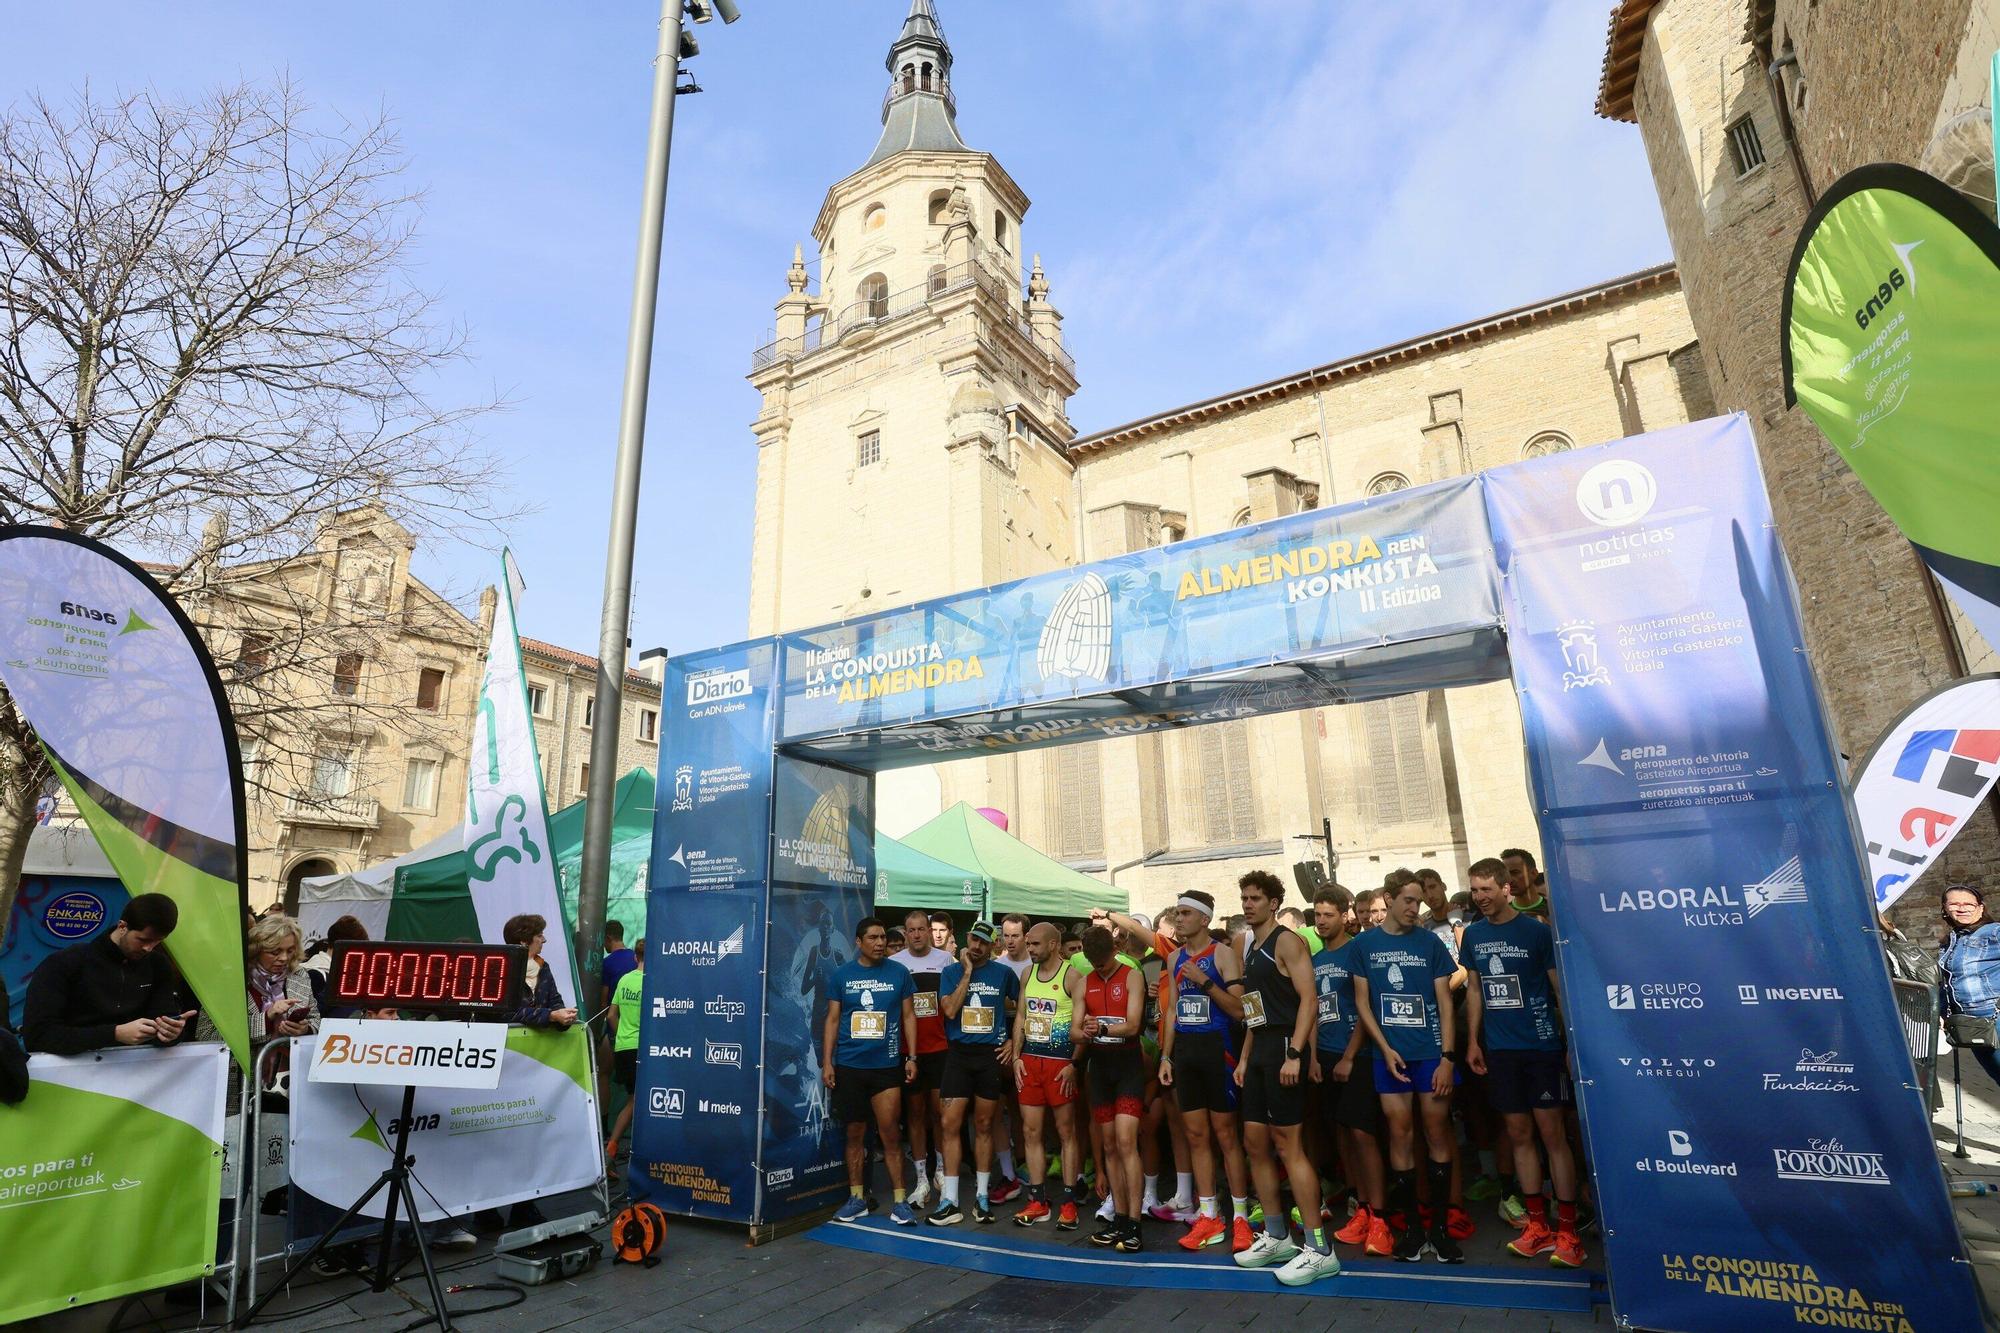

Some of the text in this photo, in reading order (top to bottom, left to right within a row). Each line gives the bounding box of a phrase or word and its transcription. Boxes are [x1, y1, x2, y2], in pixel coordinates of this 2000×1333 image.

[1580, 527, 1675, 557] noticias
[1177, 535, 1425, 602] ALMENDRA REN
[1288, 554, 1440, 603] KONKISTA
[1382, 584, 1441, 610] Edizioa
[1617, 610, 1716, 635] Ayuntamiento
[1619, 618, 1745, 647] de Vitoria-Gasteiz
[816, 645, 851, 665] Edición
[1622, 634, 1744, 661] Vitoria-Gasteizko
[806, 641, 944, 686] LA CONQUISTA
[1625, 661, 1665, 673] Udala
[693, 675, 745, 701] Diario
[805, 655, 984, 704] DE LA ALMENDRA
[689, 709, 703, 719] Con
[705, 705, 722, 716] ADN
[1620, 744, 1667, 761] aena
[1634, 750, 1750, 770] Aeropuerto de Vitoria
[1635, 763, 1742, 781] Gasteizko Aireportua
[1640, 780, 1746, 799] aeropuertos para ti
[1641, 792, 1755, 810] zuretzako aireportuak
[686, 850, 706, 860] aena
[779, 838, 842, 856] LA CONQUISTA
[779, 849, 788, 857] DE
[795, 853, 856, 872] ALMENDRA
[1600, 885, 1739, 913] LABORAL
[1684, 910, 1744, 927] kutxa
[662, 940, 717, 955] LABORAL
[1480, 946, 1520, 955] ALMENDRA
[691, 956, 716, 967] kutxa
[1377, 955, 1420, 963] ALMENDRA
[1488, 984, 1508, 997] 973
[1640, 982, 1701, 996] GRUPO
[1765, 987, 1844, 1000] INGEVEL
[665, 997, 695, 1009] adania
[705, 995, 745, 1022] udapa
[914, 998, 929, 1008] 223
[1182, 1002, 1202, 1014] 1067
[1391, 1002, 1413, 1015] 825
[1643, 997, 1704, 1010] ELEYCO
[860, 1018, 877, 1029] 519
[317, 1034, 497, 1069] Buscametas
[708, 1045, 738, 1064] Kaiku
[1619, 1058, 1716, 1068] VOLVO
[1795, 1065, 1854, 1073] MICHELIN
[1637, 1069, 1700, 1078] ARREGUI
[1762, 1073, 1859, 1092] Fundación
[450, 1096, 536, 1116] aeropuertos para ti
[711, 1102, 741, 1115] merke
[449, 1109, 544, 1130] zuretzako aireportuak
[1808, 1137, 1844, 1153] Cafés
[32, 1157, 77, 1178] para
[81, 1152, 94, 1167] ti
[649, 1162, 705, 1177] LA CONQUISTA
[1636, 1159, 1737, 1176] el Boulevard
[1773, 1149, 1889, 1179] FORONDA
[0, 1170, 105, 1199] aireportuak
[663, 1174, 719, 1192] ALMENDRA
[769, 1171, 791, 1184] Diario
[692, 1190, 731, 1205] KONKISTA
[1662, 1254, 1820, 1282] LA CONQUISTA
[1665, 1269, 1905, 1315] DE LA ALMENDRA REN
[1794, 1305, 1916, 1333] KONKISTA
